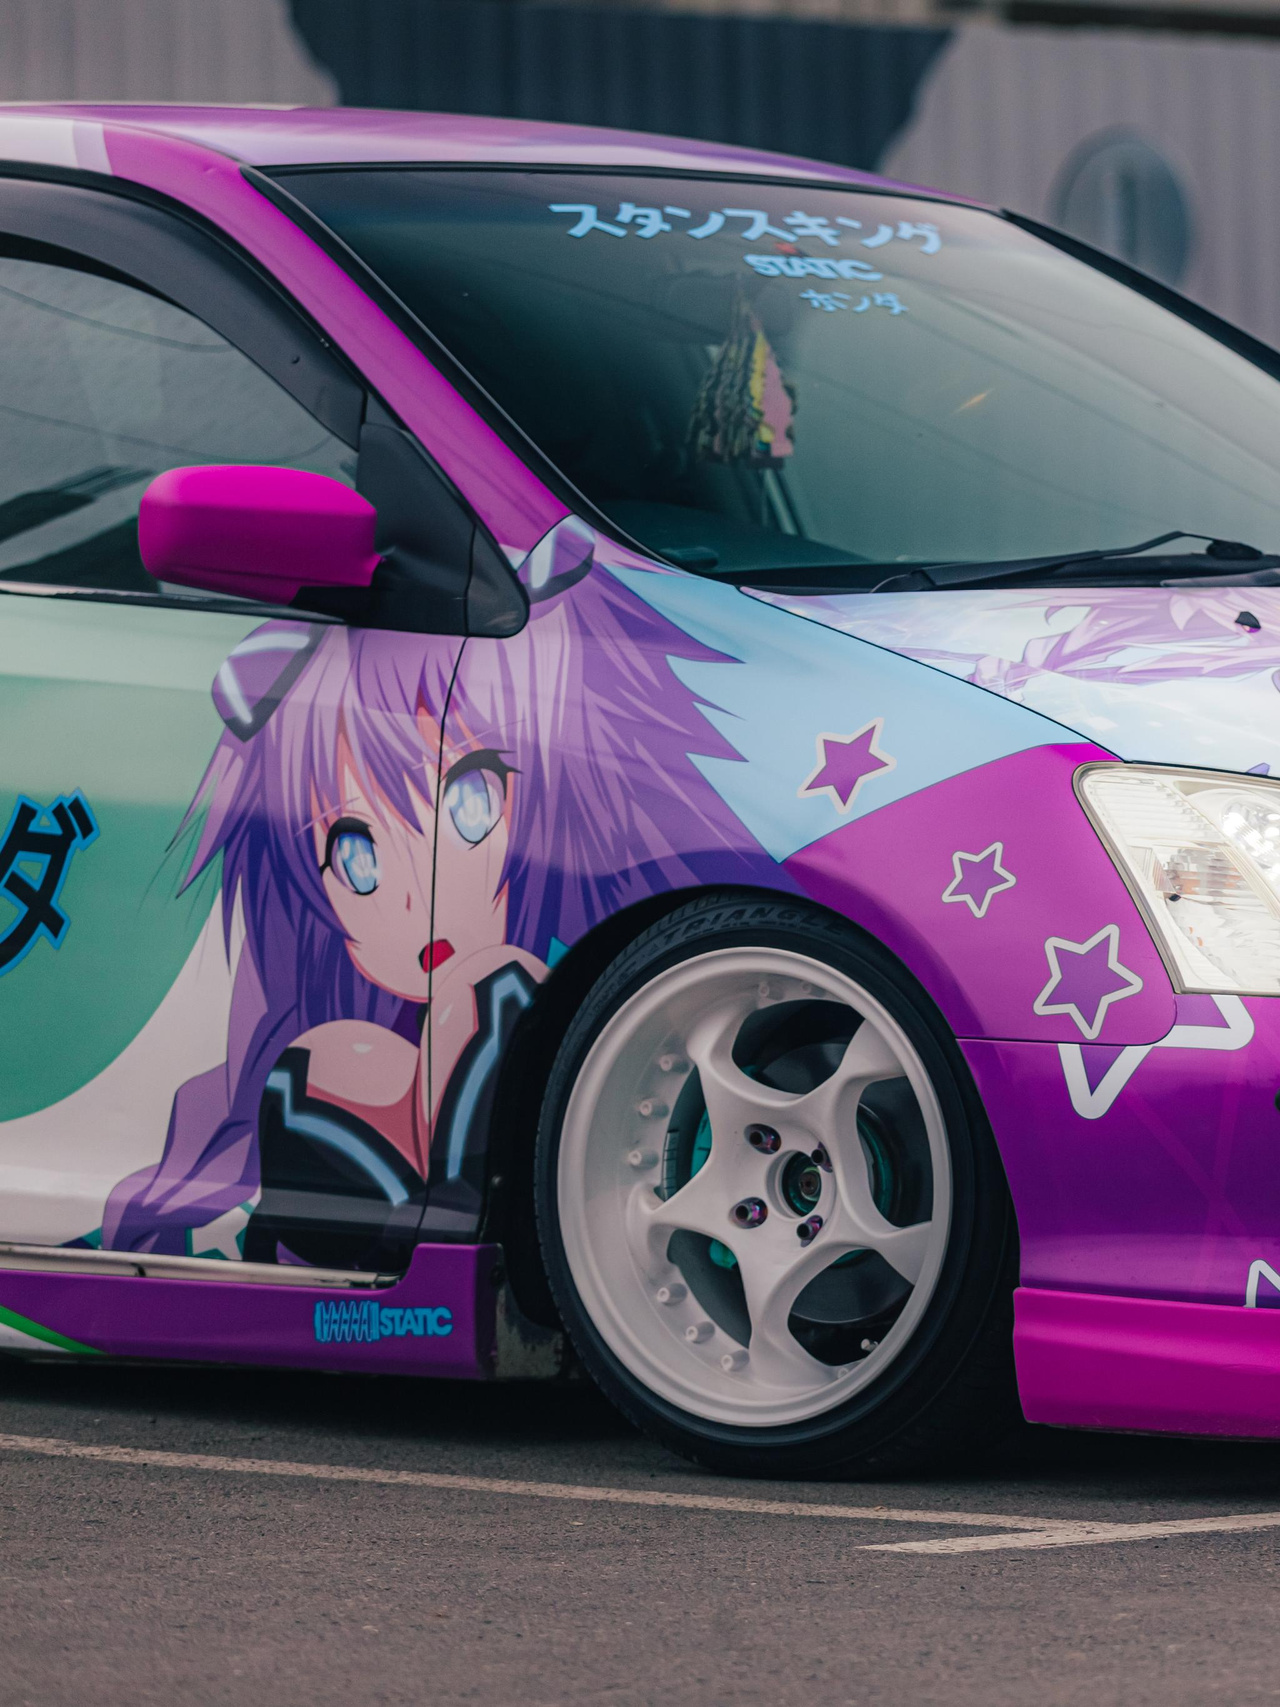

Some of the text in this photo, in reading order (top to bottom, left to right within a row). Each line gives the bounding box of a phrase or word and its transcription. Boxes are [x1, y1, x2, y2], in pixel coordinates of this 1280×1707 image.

[744, 254, 883, 281] STATIC
[663, 905, 844, 945] TRIANGLE
[380, 1306, 453, 1336] STATIC
